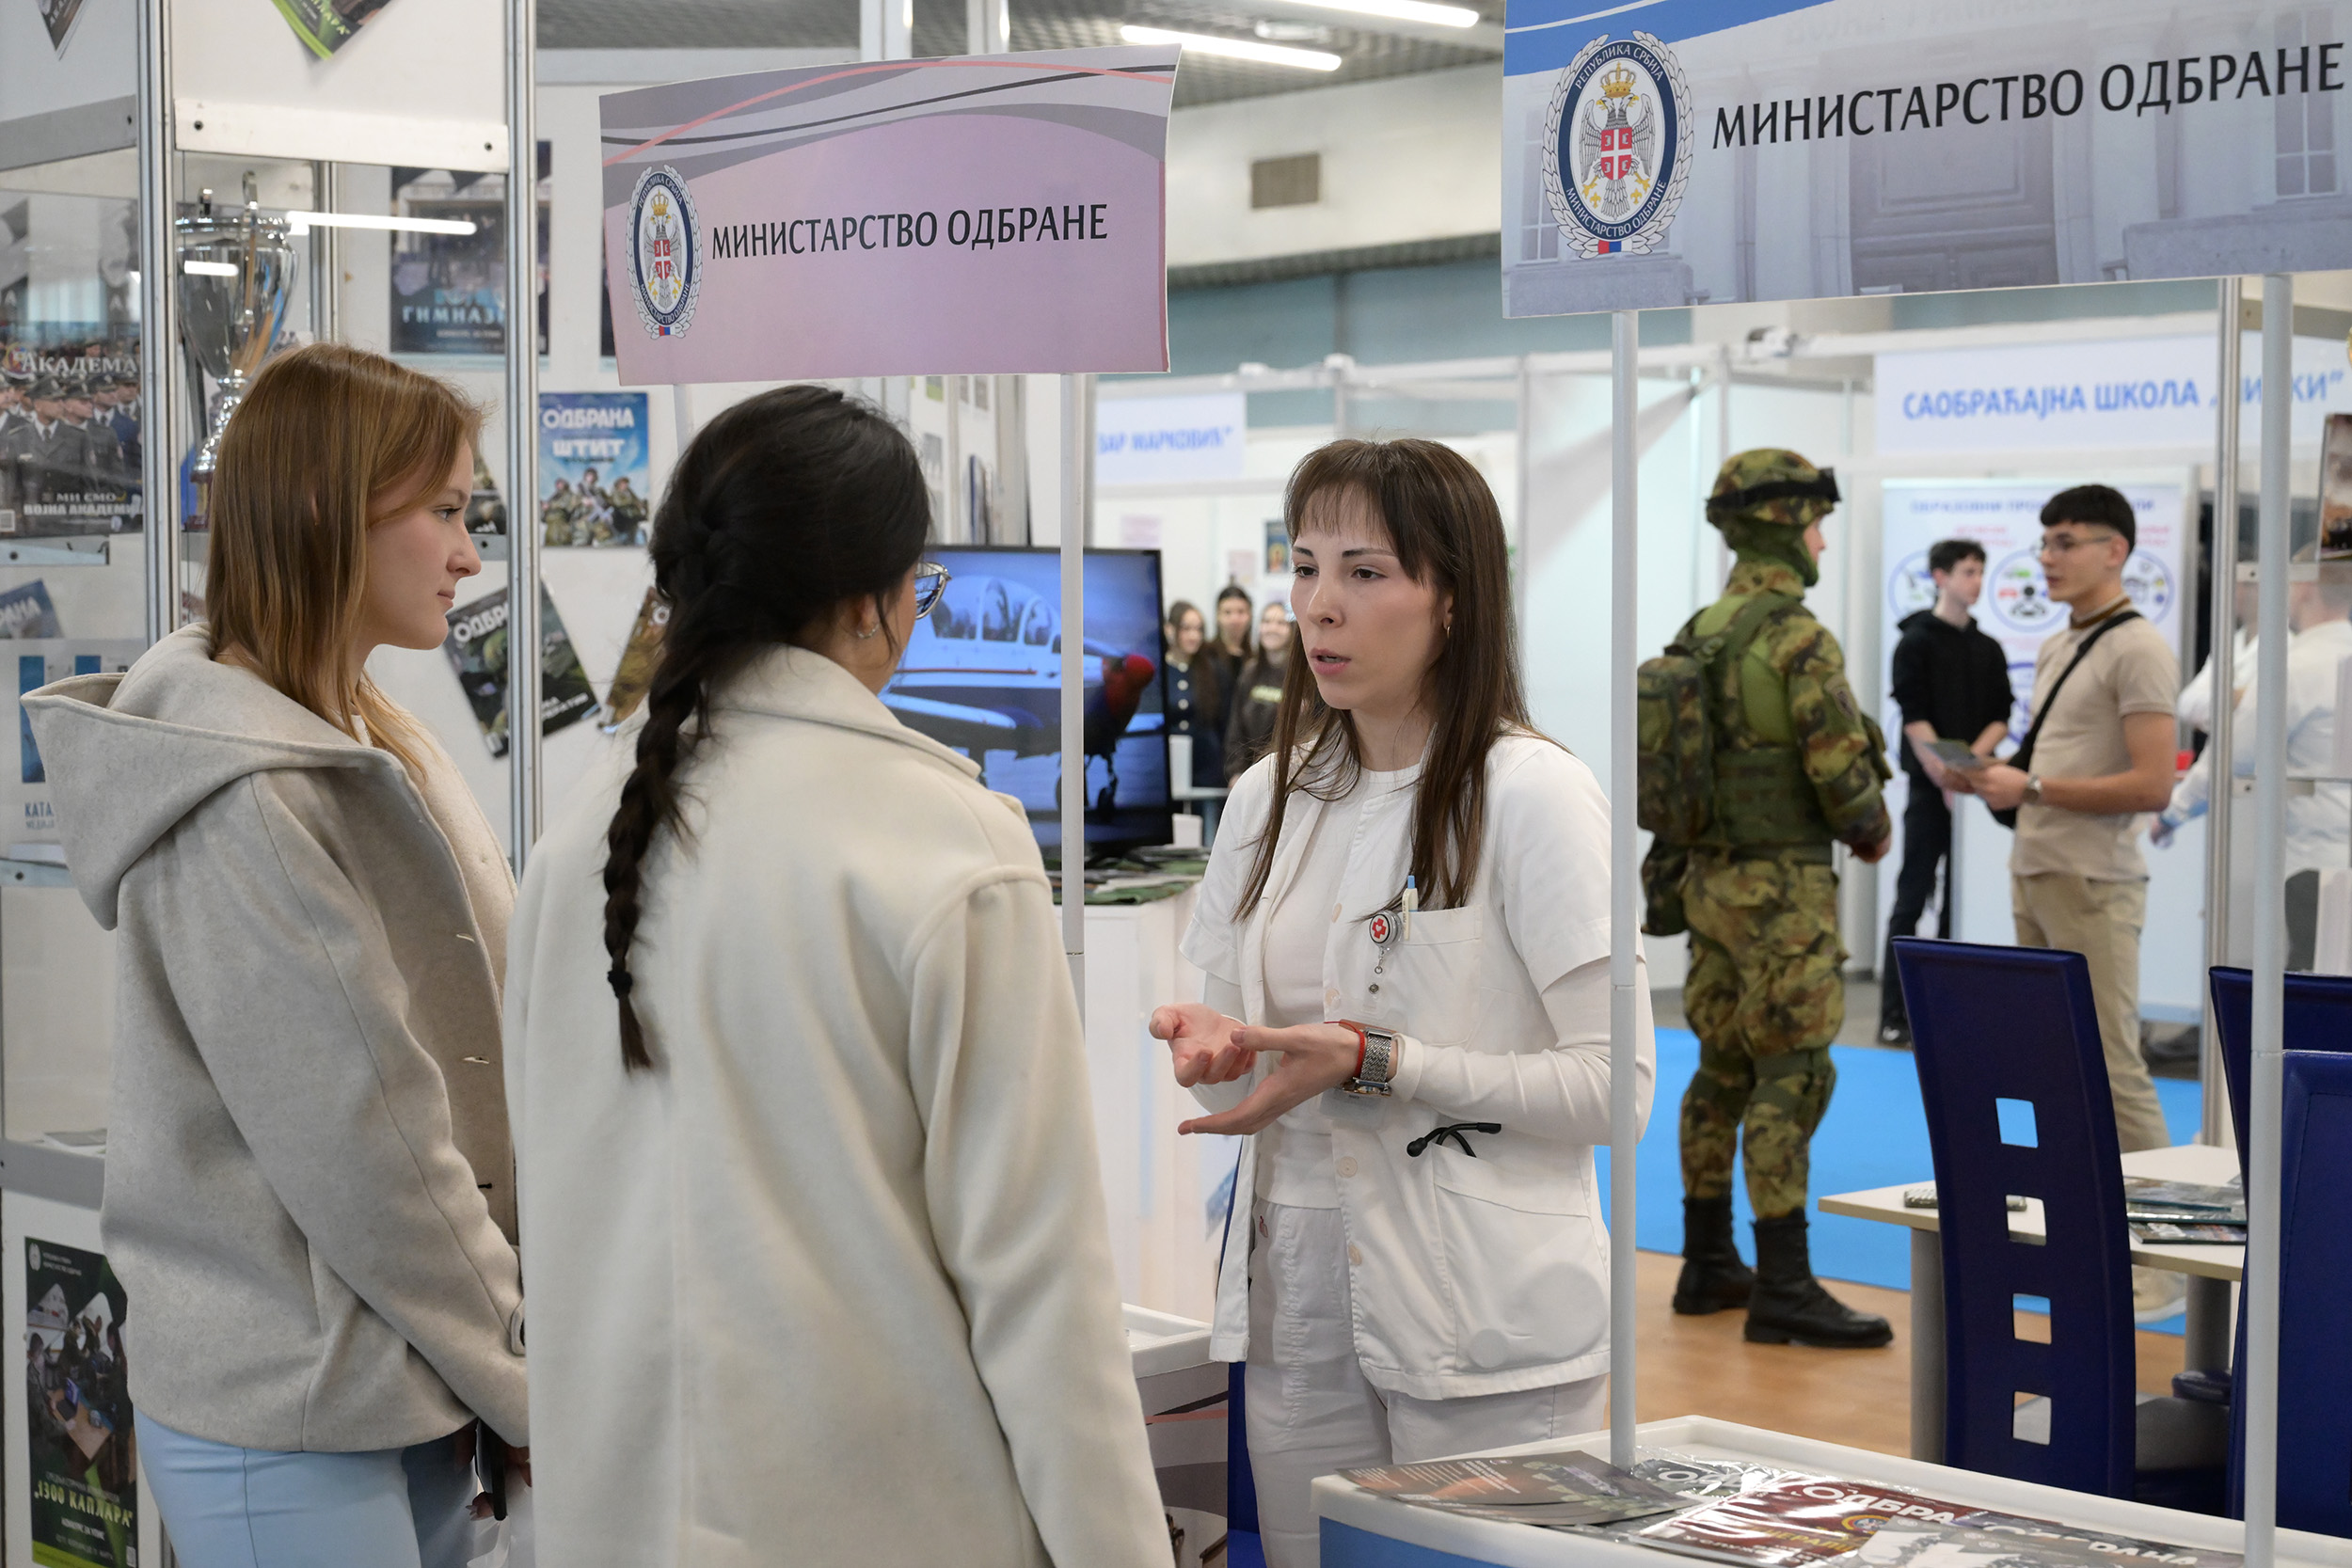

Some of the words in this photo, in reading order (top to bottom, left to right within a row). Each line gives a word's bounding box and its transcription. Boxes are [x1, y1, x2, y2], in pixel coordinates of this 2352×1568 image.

[1575, 44, 1631, 90] РЕПУБЛИКА
[1633, 46, 1664, 82] СРБИЈА
[1713, 69, 2084, 149] МИНИСТАРСТВО
[2100, 43, 2345, 117] ОДБРАНЕ
[712, 212, 939, 260] МИНИСТАРСТВО
[947, 203, 1108, 251] ОДБРАНЕ
[1565, 187, 1632, 238] МИНИСТАРСТВО
[1631, 180, 1667, 229] ОДБРАНЕ
[543, 407, 636, 429] ОДБРАНА
[1902, 384, 2087, 420] САОБРАЋАЈНА
[2094, 379, 2201, 411] ШКОЛА
[552, 438, 627, 457] ШТИТ
